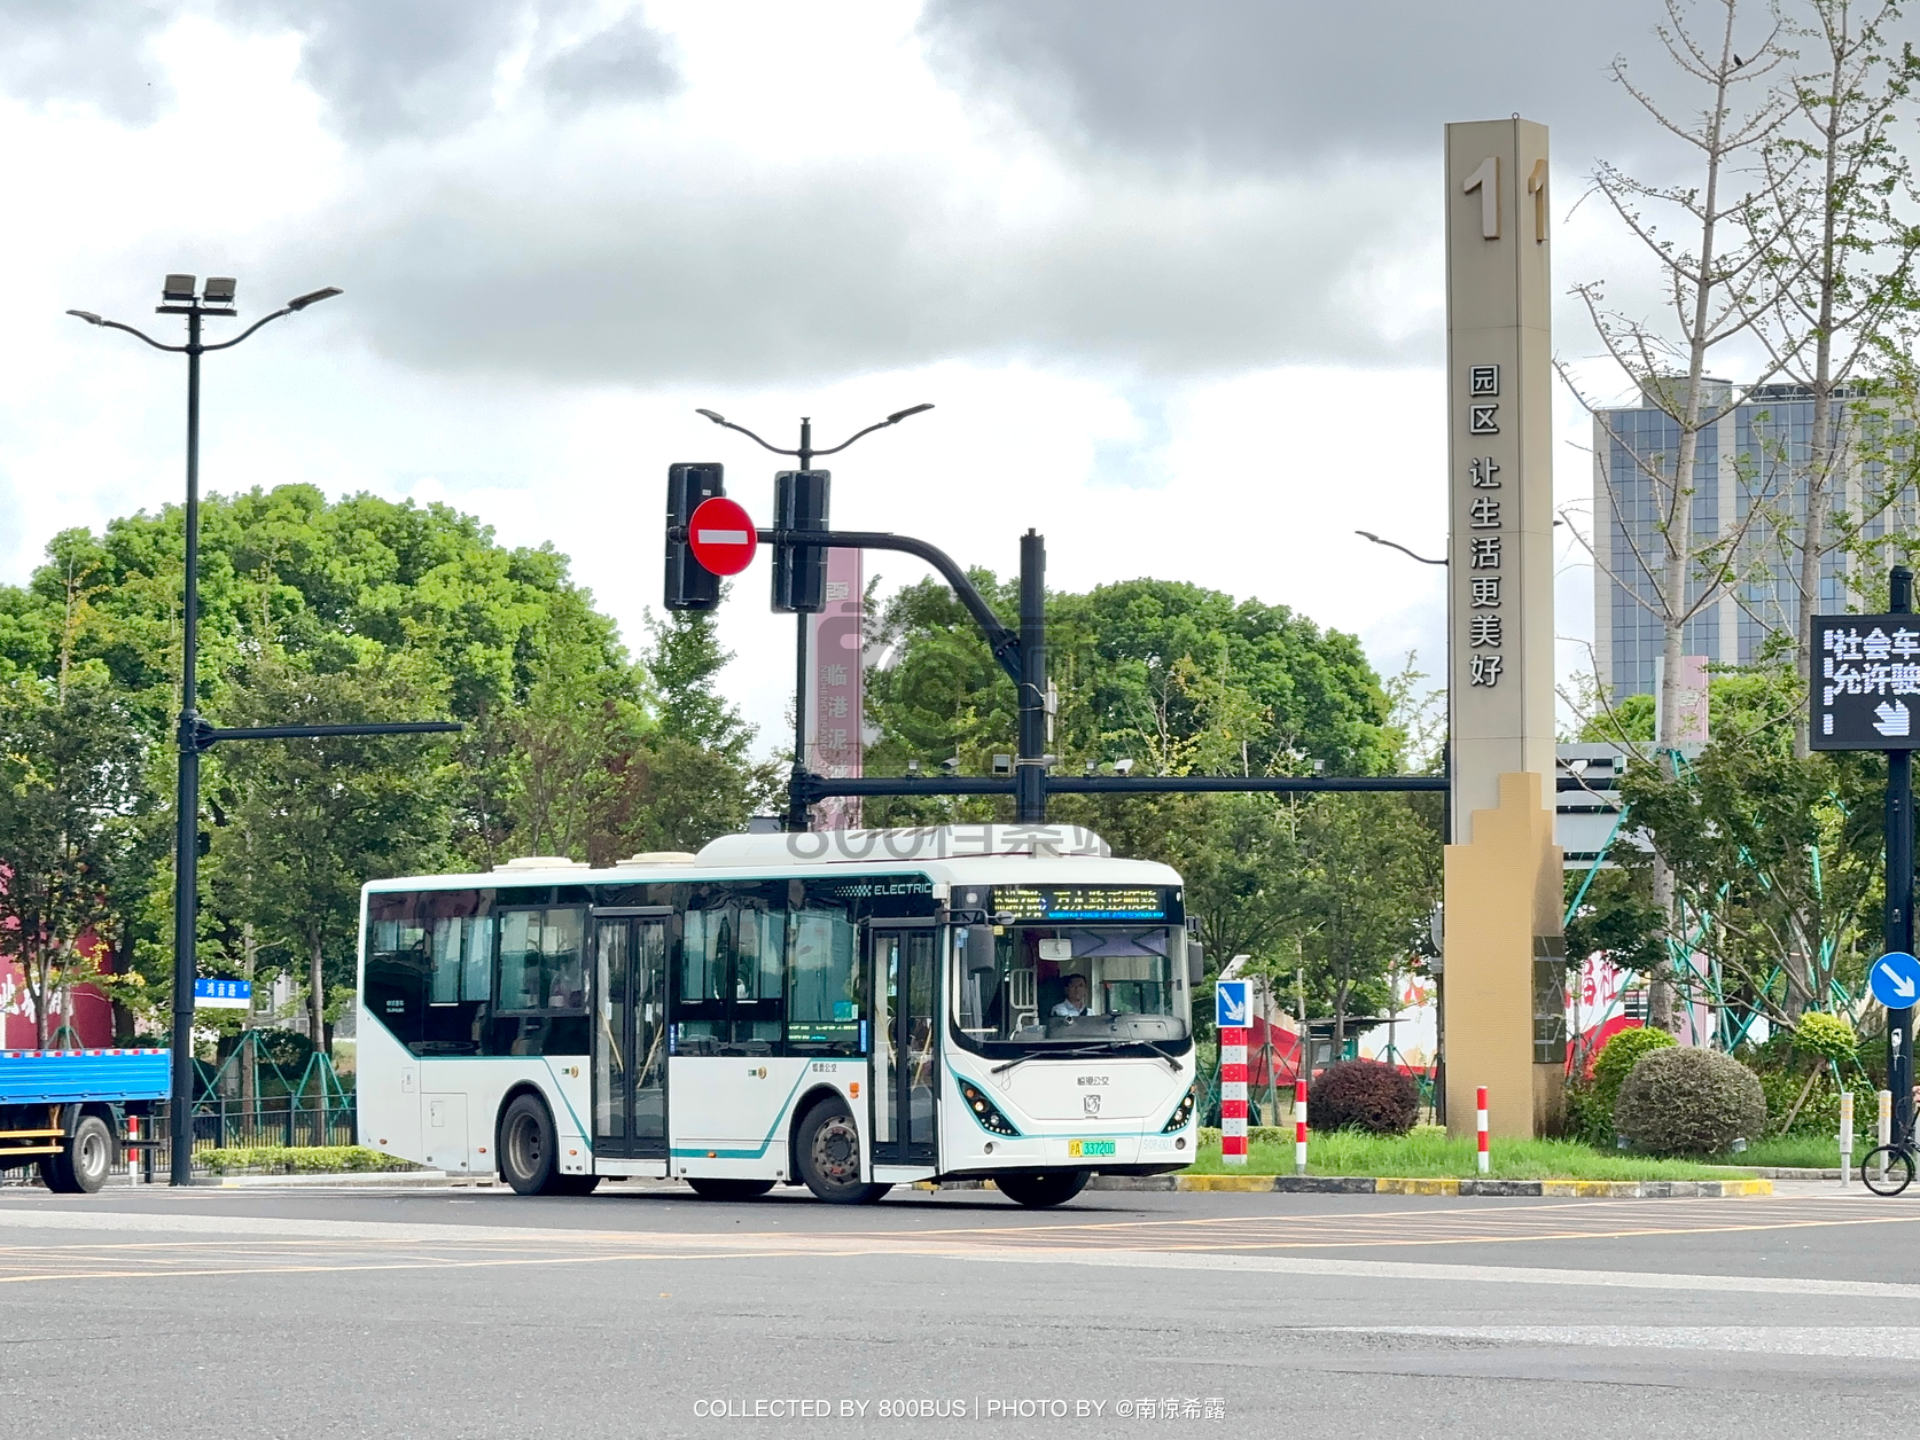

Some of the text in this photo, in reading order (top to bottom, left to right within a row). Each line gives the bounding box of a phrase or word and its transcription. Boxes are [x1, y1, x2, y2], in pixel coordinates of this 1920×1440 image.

[1463, 156, 1499, 240] 1
[1469, 364, 1502, 687] 园区 让生活更美好
[1833, 627, 1920, 660] 社会车
[819, 665, 828, 712] NICHENG
[819, 715, 828, 759] BRANCH
[874, 883, 932, 895] ELECTRIC
